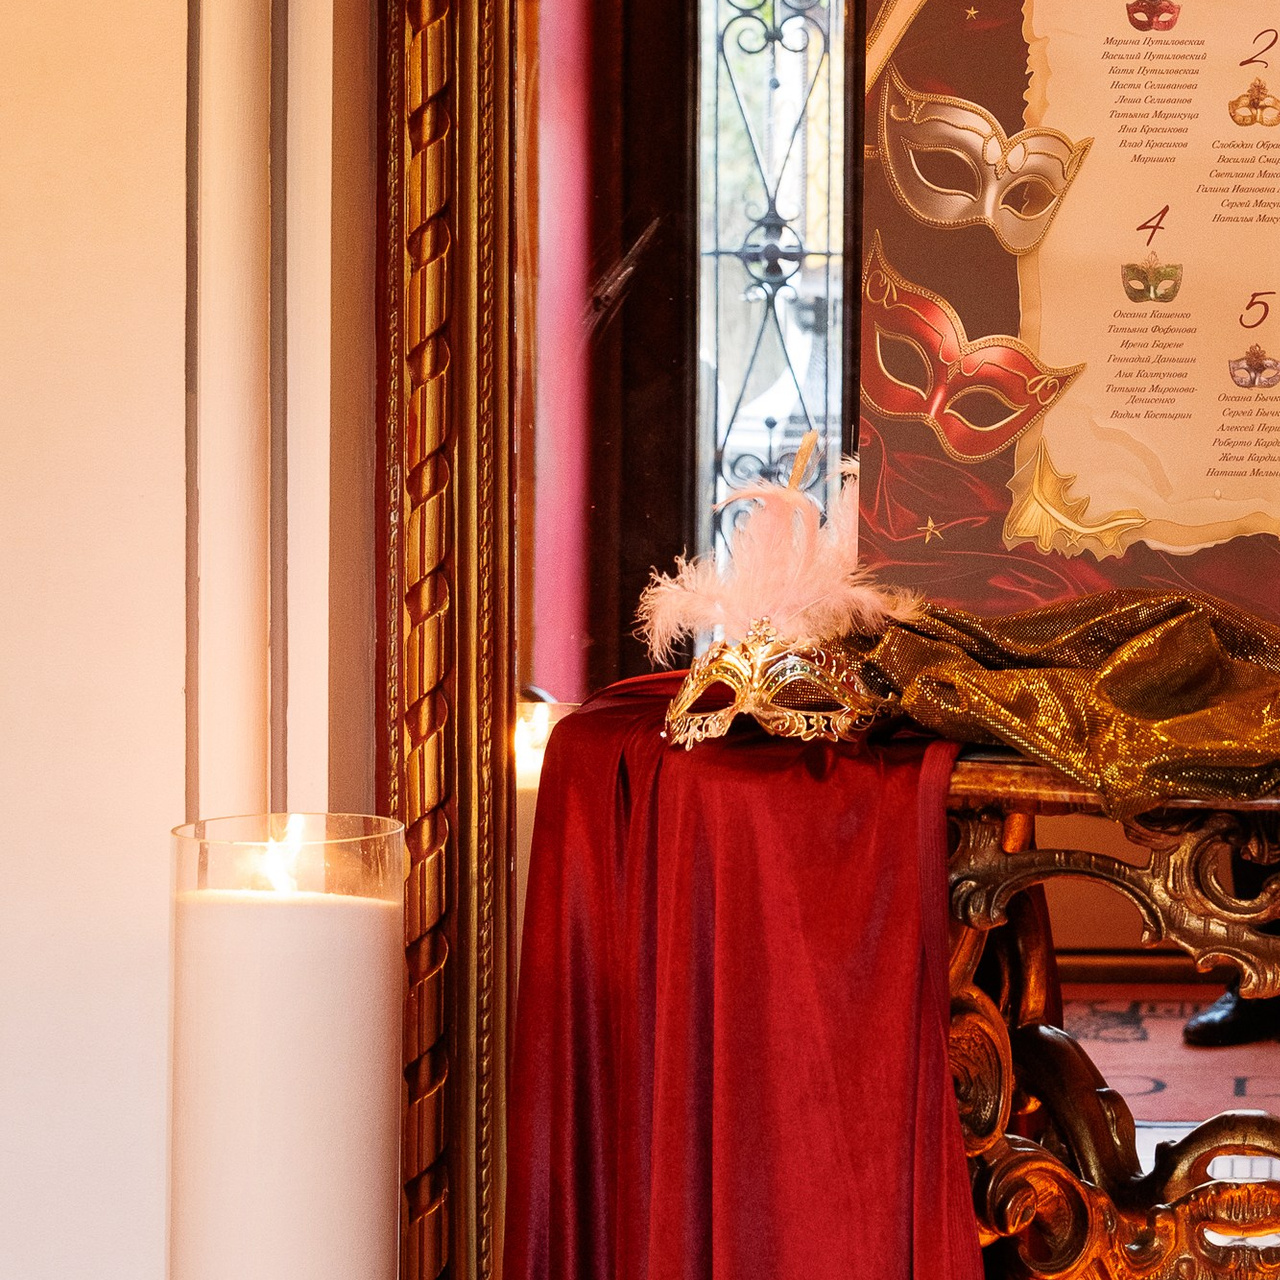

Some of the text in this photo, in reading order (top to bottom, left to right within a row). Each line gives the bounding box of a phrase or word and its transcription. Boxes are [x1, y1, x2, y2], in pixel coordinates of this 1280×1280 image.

[1103, 37, 1205, 48] Марина Путиловская
[1239, 29, 1278, 68] 2
[1101, 52, 1207, 62] Василий Путиловский
[1109, 67, 1199, 77] Катя Путиловская
[1110, 81, 1198, 90] Настя Селиванова
[1115, 96, 1192, 104] Леша Селиванов
[1118, 125, 1188, 135] Яна Красикова
[1119, 140, 1188, 150] Влад Красиков
[1131, 155, 1176, 164] Маришка
[1209, 170, 1254, 178] Светлана
[1196, 185, 1230, 193] Галина
[1232, 185, 1275, 193] Ивановна
[1221, 200, 1250, 209] Сергей
[1212, 215, 1254, 223] Наталья
[1136, 204, 1169, 246] 4
[1113, 310, 1147, 318] Оксана
[1239, 291, 1276, 329] 5
[1107, 325, 1148, 333] Татьяна
[1107, 355, 1151, 363] Геннадий
[1115, 370, 1188, 379] Аня Колтунова
[1105, 385, 1147, 393] Татьяна
[1125, 396, 1176, 405] Денисенко
[1218, 394, 1252, 402] Оксана
[1110, 411, 1192, 420] Вадим Костырин
[1222, 409, 1253, 418] Сергей
[1217, 424, 1255, 432] Алексей
[1212, 439, 1252, 448] Роберто
[1206, 469, 1247, 477] Наташа
